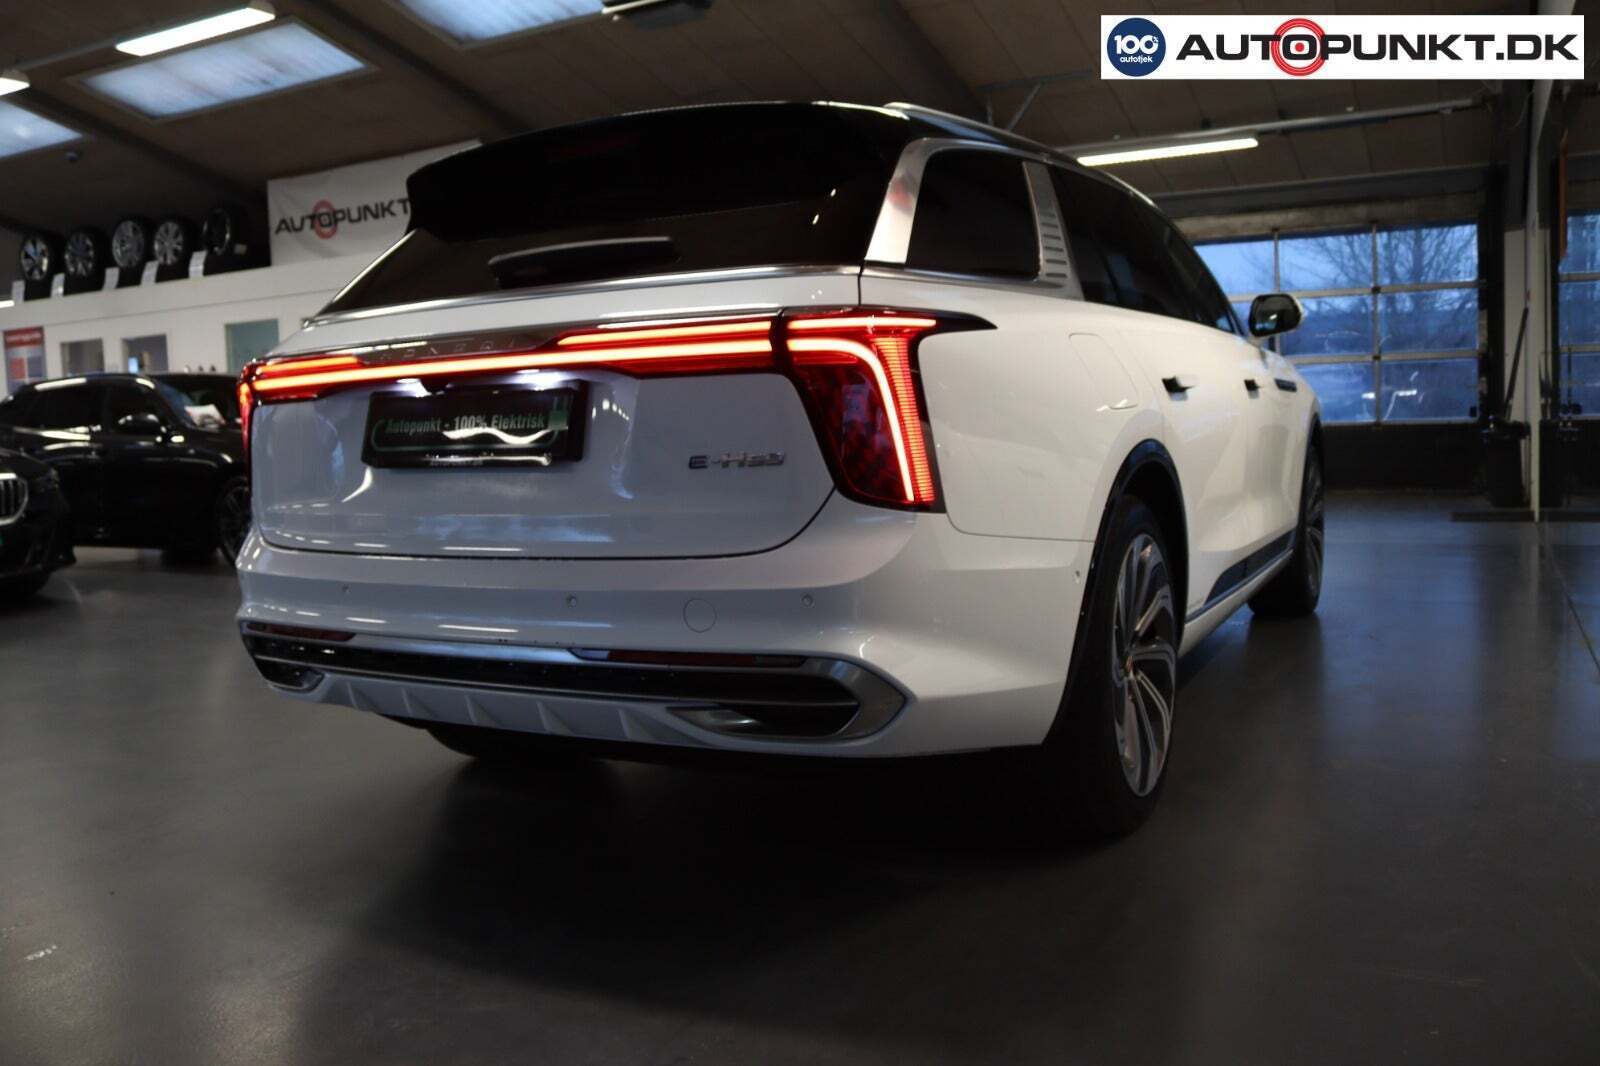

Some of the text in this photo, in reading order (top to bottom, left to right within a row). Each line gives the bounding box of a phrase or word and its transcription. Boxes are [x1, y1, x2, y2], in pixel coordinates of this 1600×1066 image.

[274, 198, 411, 235] AUTOPUNKT
[385, 418, 442, 436] Autopunkt
[453, 415, 488, 430] 100%
[491, 413, 545, 431] Elektrisk
